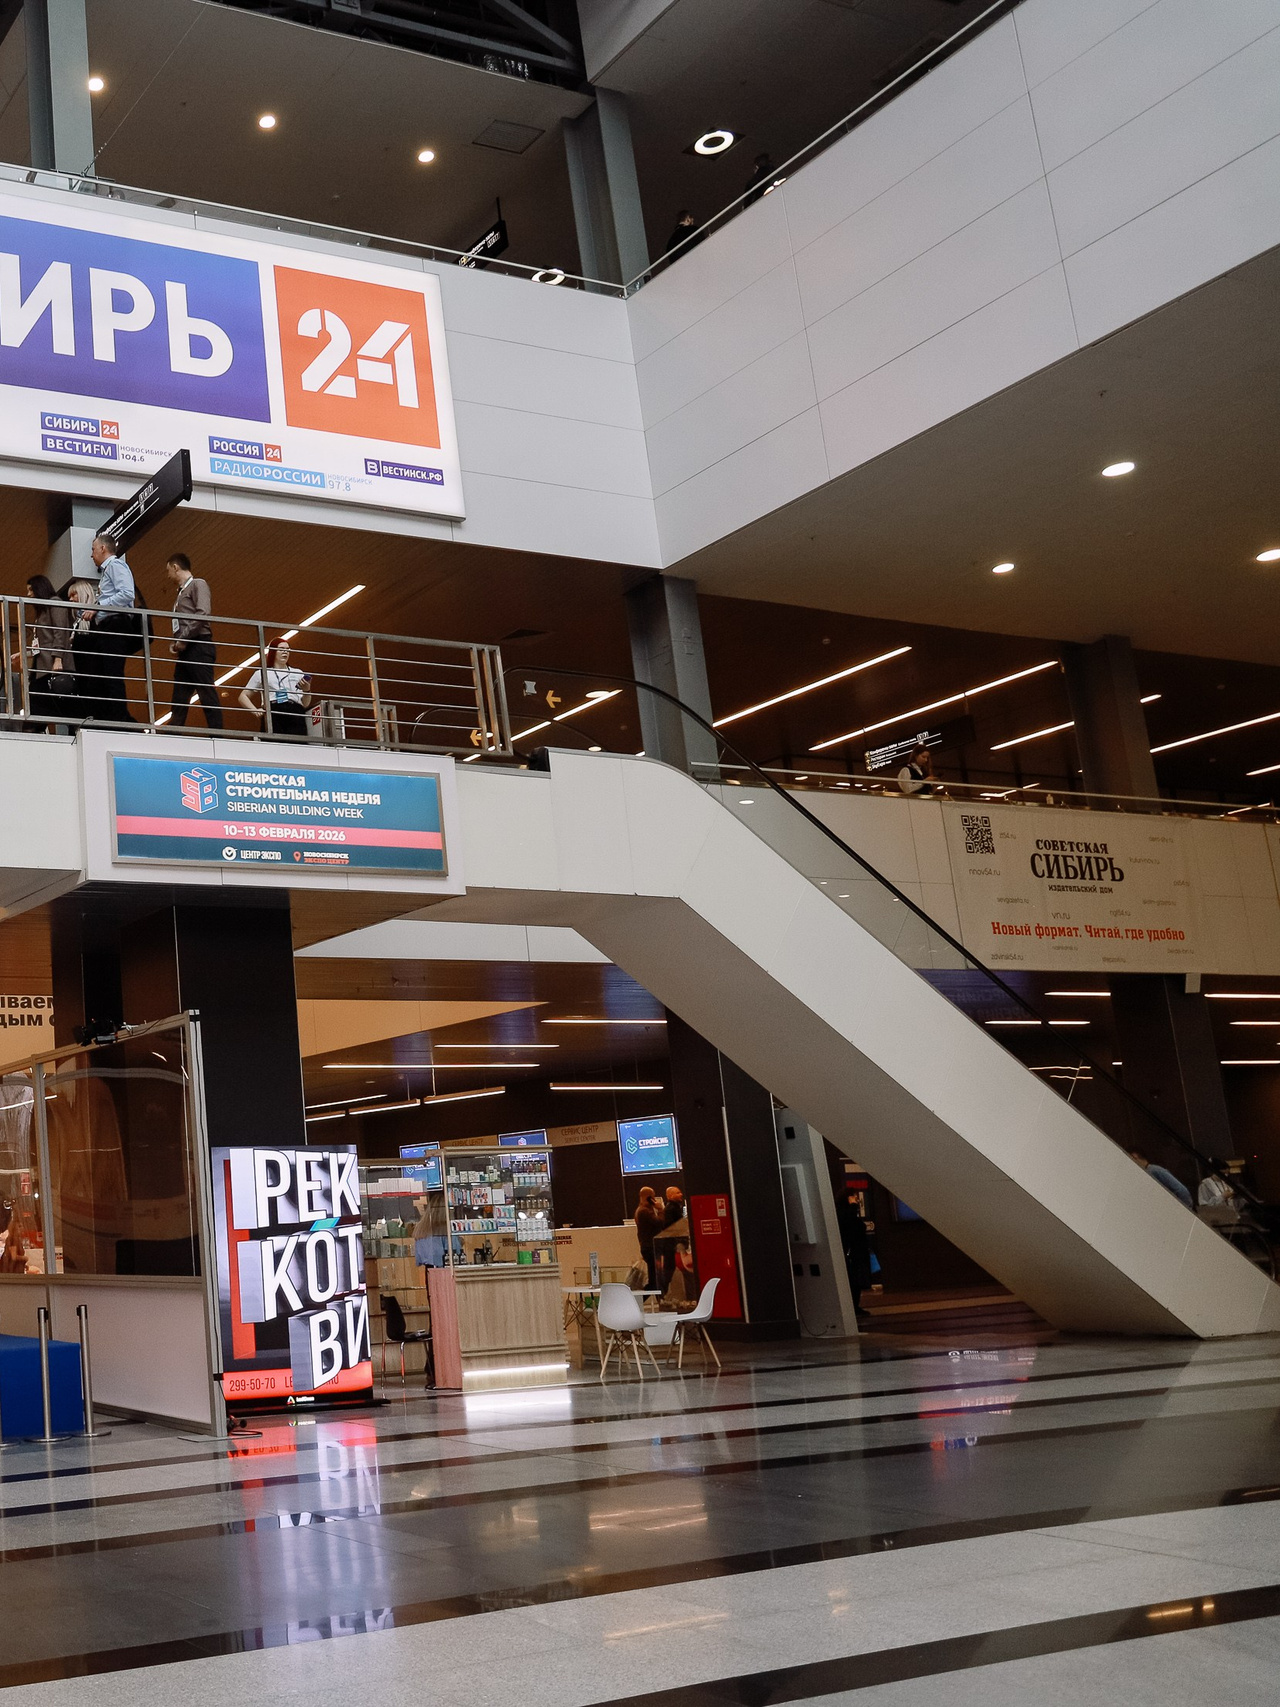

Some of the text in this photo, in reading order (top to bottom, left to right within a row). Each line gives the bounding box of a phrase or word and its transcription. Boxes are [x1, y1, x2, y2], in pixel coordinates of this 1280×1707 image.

[297, 307, 418, 408] 24
[45, 415, 118, 436] СИБИРЬ 24
[46, 438, 112, 456] ВЕСТИFM
[120, 446, 173, 457] НОВОСИБИРСК
[213, 440, 281, 460] РОССИЯ 24
[121, 454, 145, 463] 104.6
[214, 460, 322, 486] РАДИОРОССИИ
[327, 473, 373, 485] НОВОСИБИРСК
[382, 465, 443, 483] ВЕСТИНСК.РФ
[328, 480, 352, 492] 97.8
[224, 771, 306, 788] СИБИРСКАЯ
[226, 785, 381, 806] СТРОИТЕЛЬНАЯ НЕДЕЛЯ
[227, 801, 365, 819] SIBERIAN BUILDING WEEK
[223, 824, 346, 842] 10-13 ФЕВРАЛЯ 2026
[240, 849, 282, 861] ЦЕНТР ЭКСПО
[303, 851, 350, 860] НОВОСИБИРСК
[1035, 839, 1109, 855] СОВЕТСКАЯ
[1030, 853, 1125, 882] СИБИРЬ
[1099, 886, 1114, 894] дом
[991, 921, 1186, 942] Новый формат. Читай, где удобно
[561, 1125, 599, 1136] СЕРВИС ЦЕНТР
[639, 1136, 669, 1147] СТРОЙСИБ
[253, 1149, 361, 1229] РЕК
[229, 1378, 276, 1392] 299-50-70
